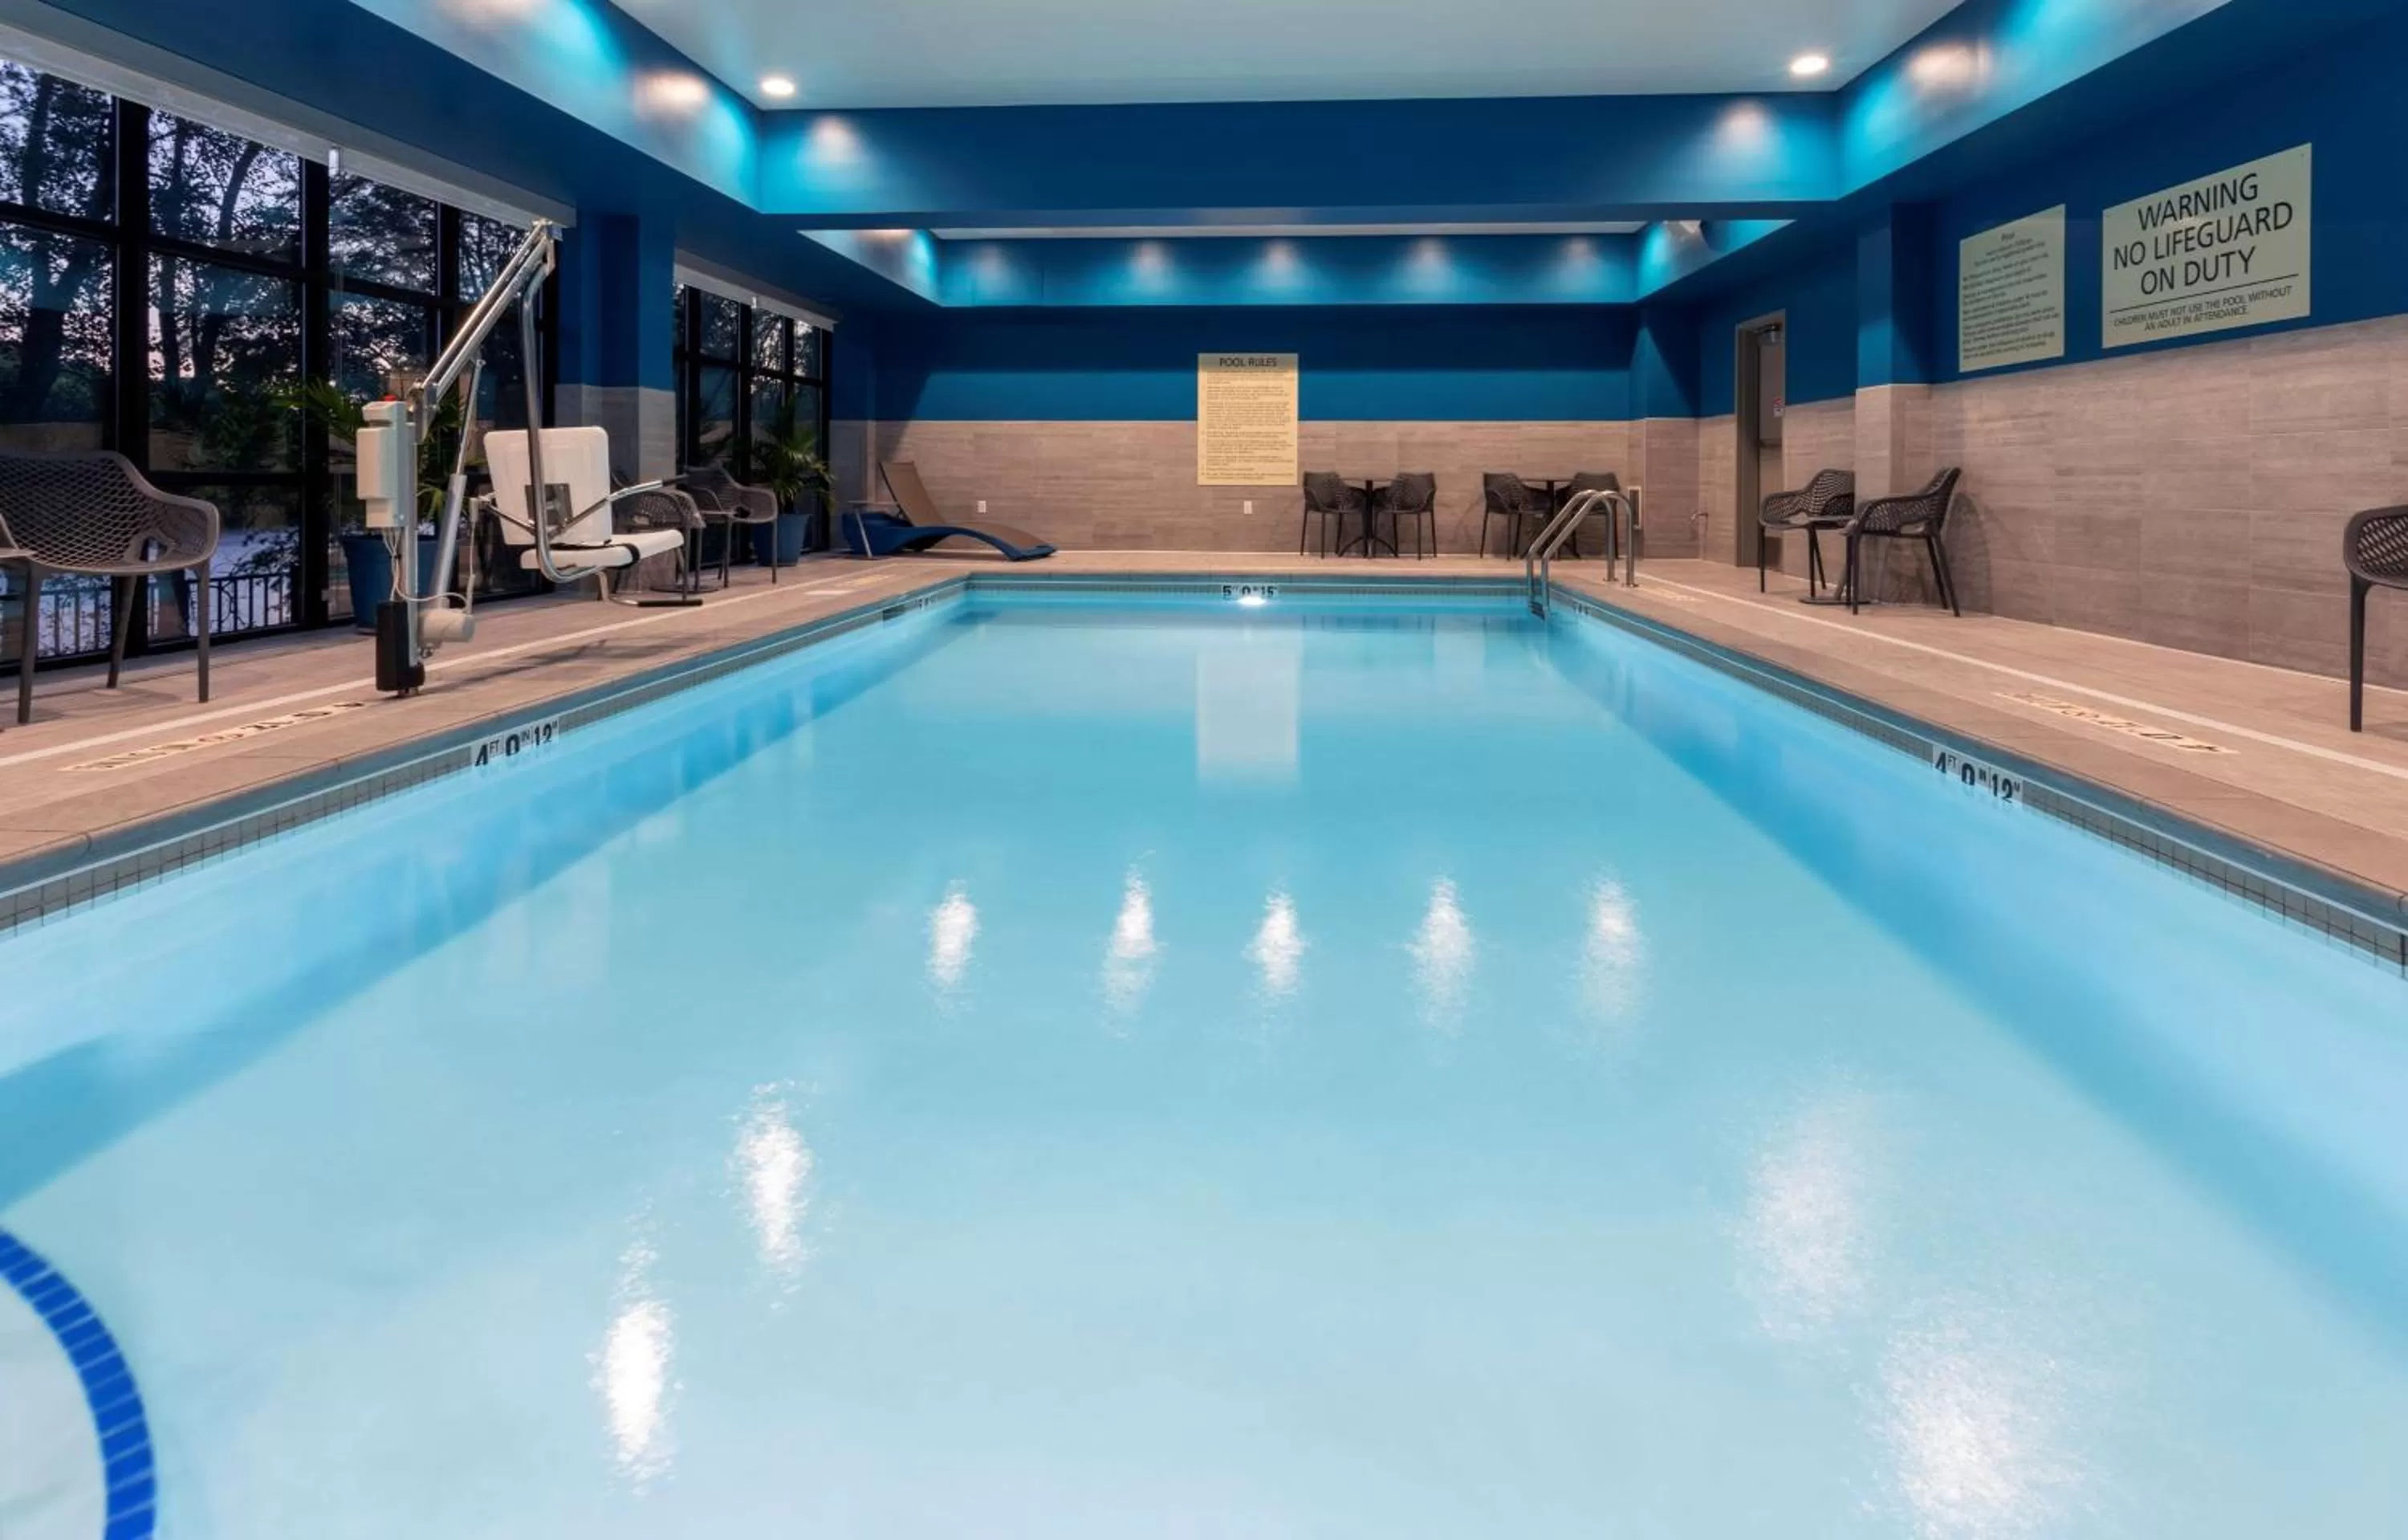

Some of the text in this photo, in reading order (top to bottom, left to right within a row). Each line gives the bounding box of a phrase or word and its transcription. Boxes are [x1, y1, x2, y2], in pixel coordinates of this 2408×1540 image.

[2138, 173, 2259, 232] WARNING
[2113, 202, 2293, 271] NO LIFEGUARD
[2141, 245, 2256, 295] ON DUTY
[2248, 285, 2293, 303] WITHOUT
[1219, 356, 1278, 368] POOL RULES
